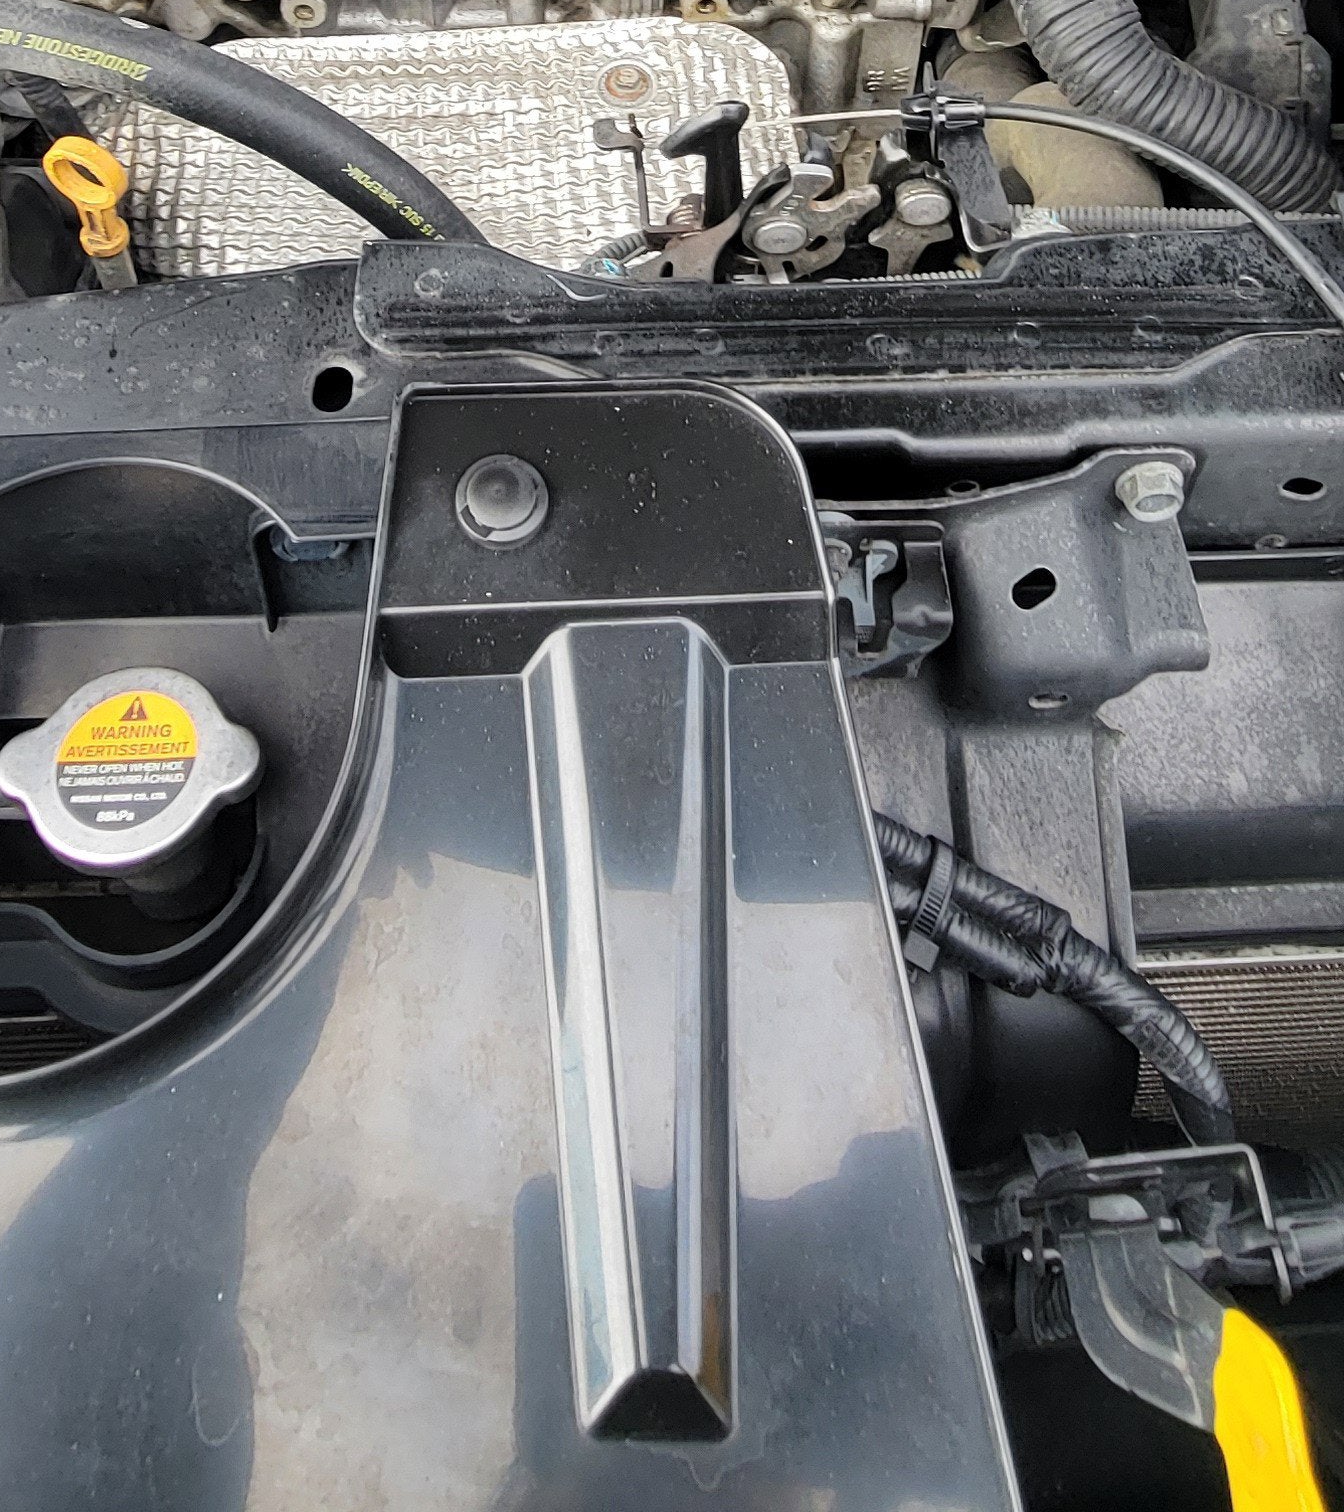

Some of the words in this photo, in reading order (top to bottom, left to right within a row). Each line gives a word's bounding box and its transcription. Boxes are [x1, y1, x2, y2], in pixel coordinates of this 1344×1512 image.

[22, 33, 153, 82] BRIDGESTONE
[91, 724, 172, 740] WARNING
[66, 741, 190, 757] AVERTISSEMENT
[63, 764, 98, 775] NEVER
[99, 764, 128, 774] OPEN
[129, 762, 161, 773] WHEN
